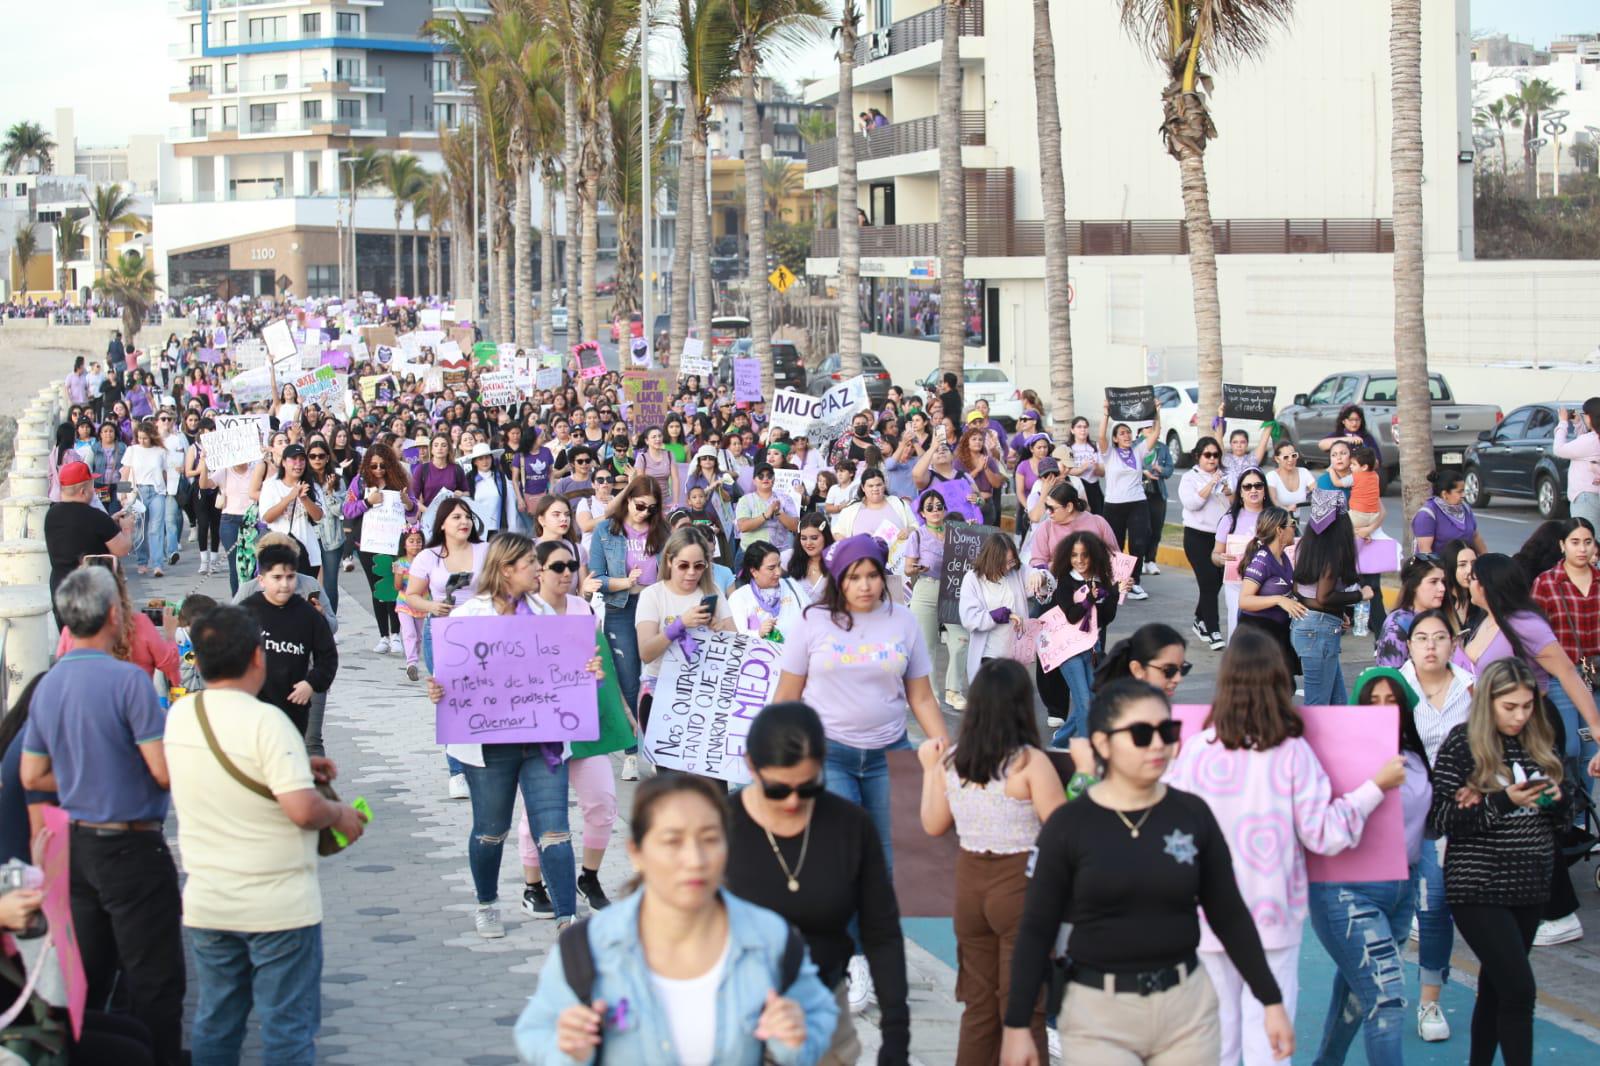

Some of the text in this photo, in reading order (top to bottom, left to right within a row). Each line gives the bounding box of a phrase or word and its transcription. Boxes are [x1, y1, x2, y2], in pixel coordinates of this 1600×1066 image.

[251, 247, 276, 260] 1100
[641, 403, 662, 415] PARA
[947, 557, 961, 572] de
[444, 622, 560, 669] Somos las
[504, 675, 523, 689] de
[528, 674, 545, 685] las
[548, 664, 591, 686] Brujas
[731, 647, 776, 720] MIEDO
[449, 692, 560, 714] que no pudiste
[682, 713, 706, 760] TANTO
[695, 671, 719, 708] QUE
[654, 724, 684, 758] Nos
[705, 712, 729, 773] MINARON
